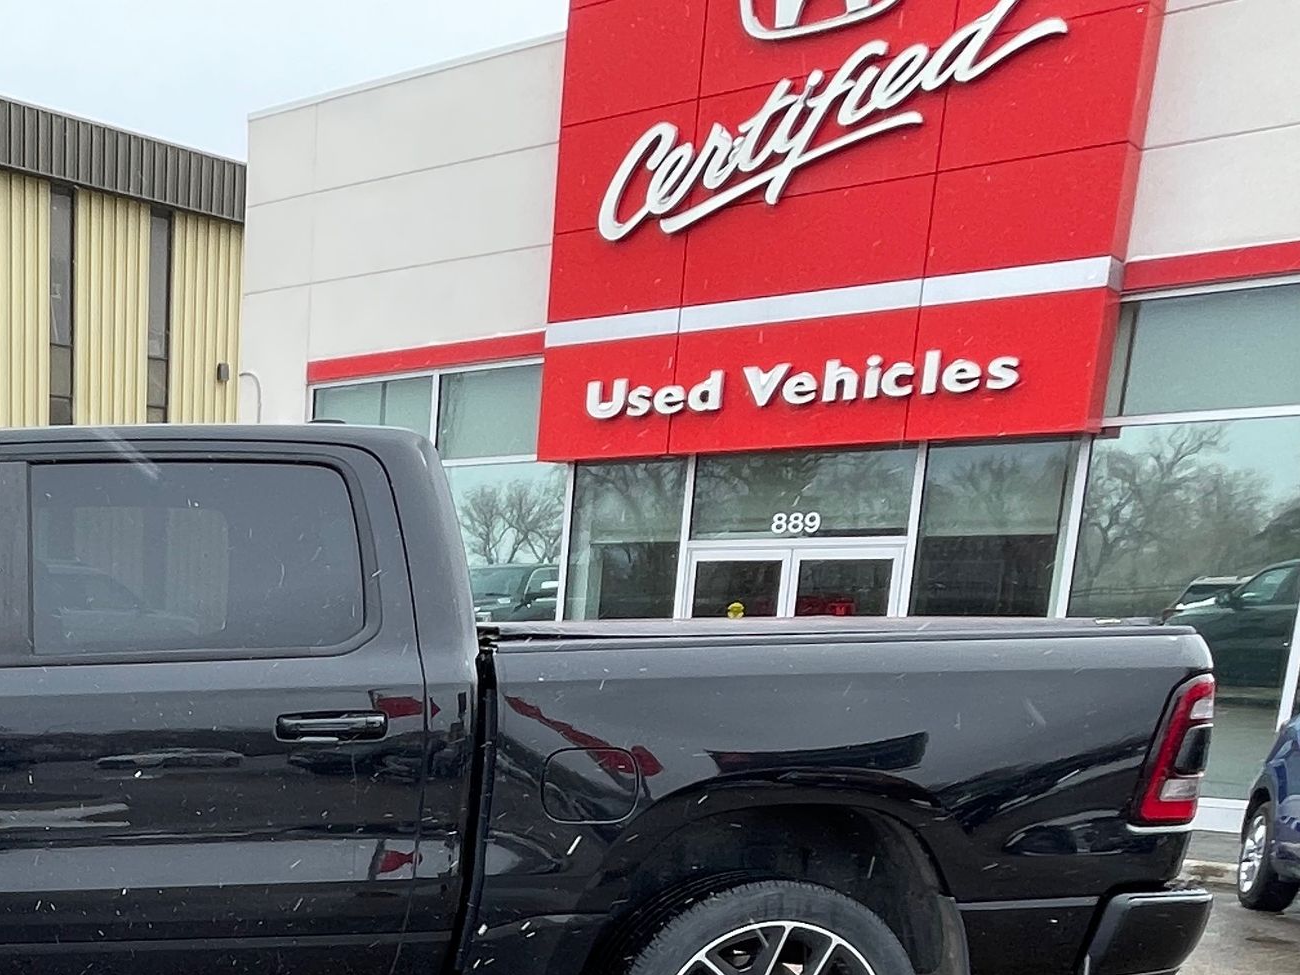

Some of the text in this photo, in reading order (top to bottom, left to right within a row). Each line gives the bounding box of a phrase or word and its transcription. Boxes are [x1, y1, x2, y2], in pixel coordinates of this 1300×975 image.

[598, 0, 1069, 242] Certified
[585, 348, 1021, 420] Used Vehicles
[770, 511, 822, 534] 889
